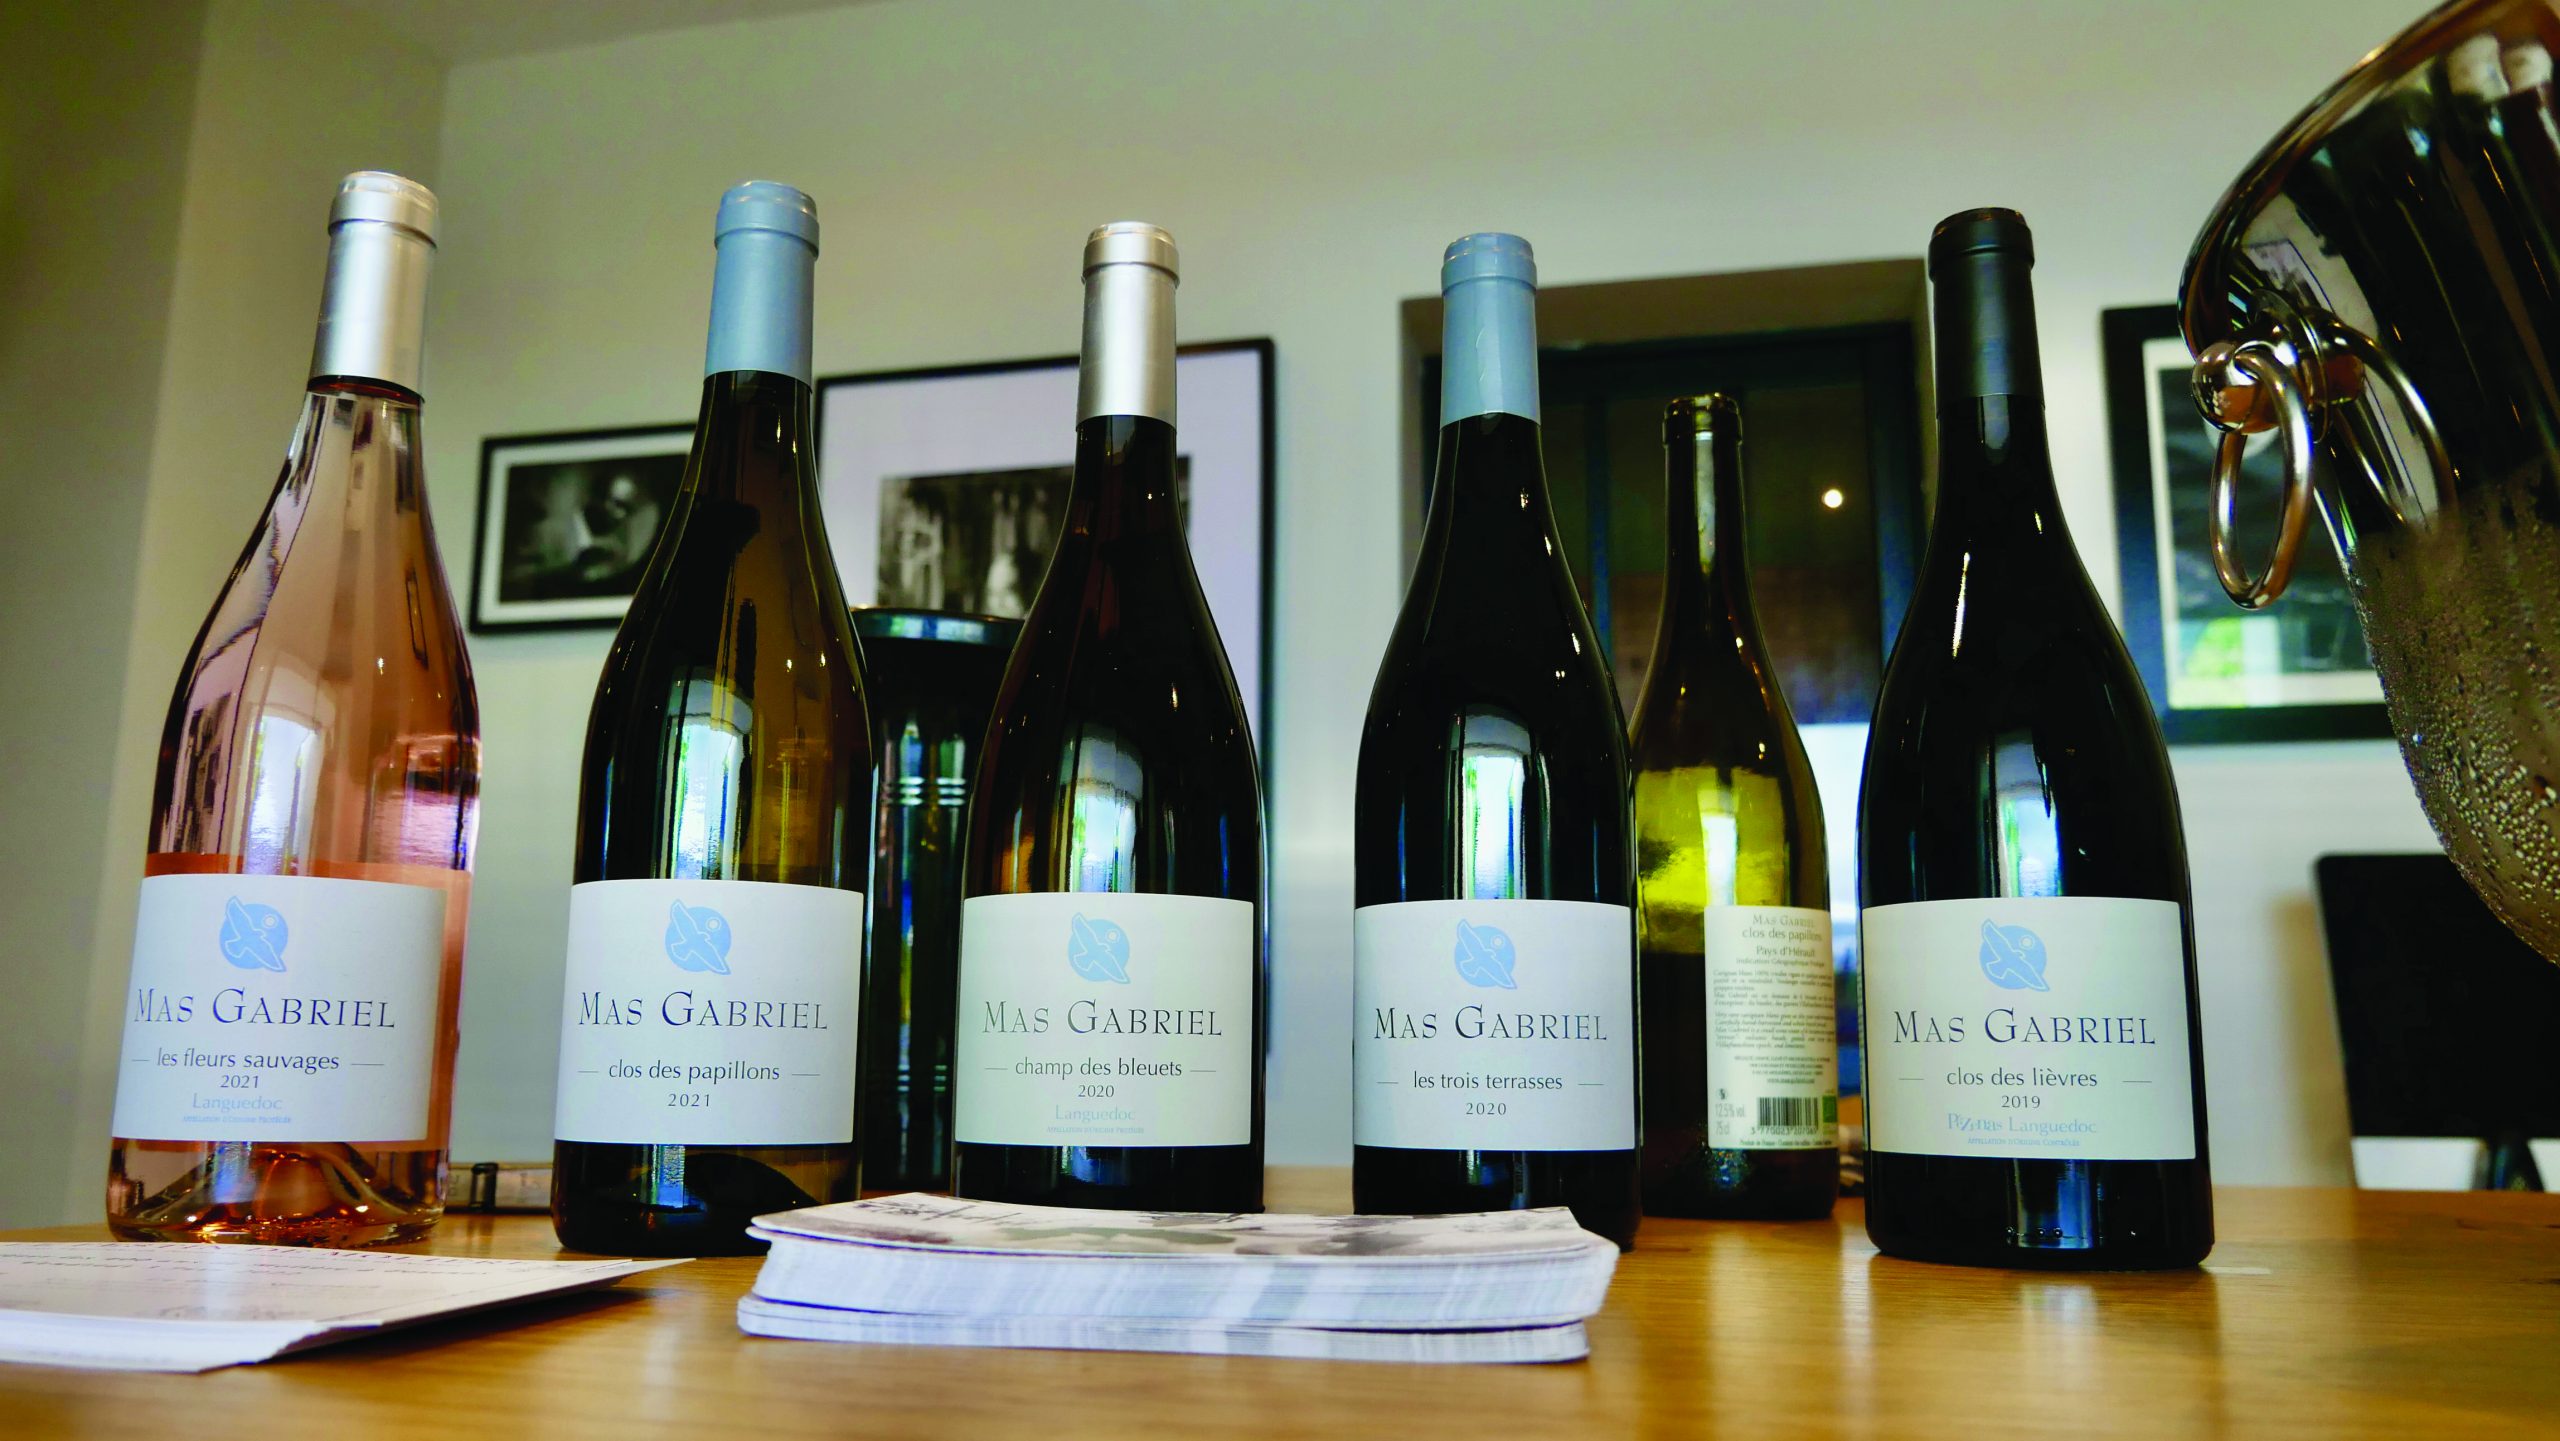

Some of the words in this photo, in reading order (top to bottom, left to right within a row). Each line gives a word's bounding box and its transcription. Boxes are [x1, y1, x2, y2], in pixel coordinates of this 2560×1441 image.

[1742, 927, 1765, 938] clos
[1769, 928, 1786, 939] des
[1756, 946, 1777, 957] Pays
[134, 988, 194, 1023] MAS
[212, 986, 396, 1029] GABRIEL
[578, 991, 643, 1026] MAS
[661, 990, 828, 1030] GABRIEL
[982, 1001, 1050, 1034] MAS
[1067, 999, 1223, 1037] GABRIEL
[1373, 1007, 1437, 1040] MAS
[1454, 1004, 1608, 1041] GABRIEL
[1893, 1010, 1966, 1044] MAS
[1984, 1006, 2156, 1045] GABRIEL
[156, 1047, 178, 1067] les
[183, 1047, 236, 1069] fleurs
[243, 1053, 340, 1075] sauvages
[1015, 1056, 1073, 1080] champ
[1080, 1057, 1111, 1077] des
[1118, 1057, 1182, 1077] bleuets
[220, 1075, 260, 1089] 2021
[609, 1059, 643, 1080] clos
[649, 1060, 681, 1080] des
[688, 1060, 780, 1085] papillons
[1413, 1070, 1435, 1090] les
[1440, 1072, 1479, 1090] trois
[1486, 1073, 1563, 1090] terrasses
[1946, 1067, 1984, 1086] clos
[1991, 1067, 2025, 1087] des
[2033, 1067, 2098, 1087] lièvres
[667, 1093, 711, 1108] 2021
[1077, 1084, 1115, 1098] 2020
[192, 1092, 282, 1113] Languedoc
[1465, 1102, 1507, 1116] 2020
[2001, 1095, 2042, 1109] 2019
[1055, 1104, 1136, 1122] Languedoc
[2009, 1116, 2098, 1137] Languedoc
